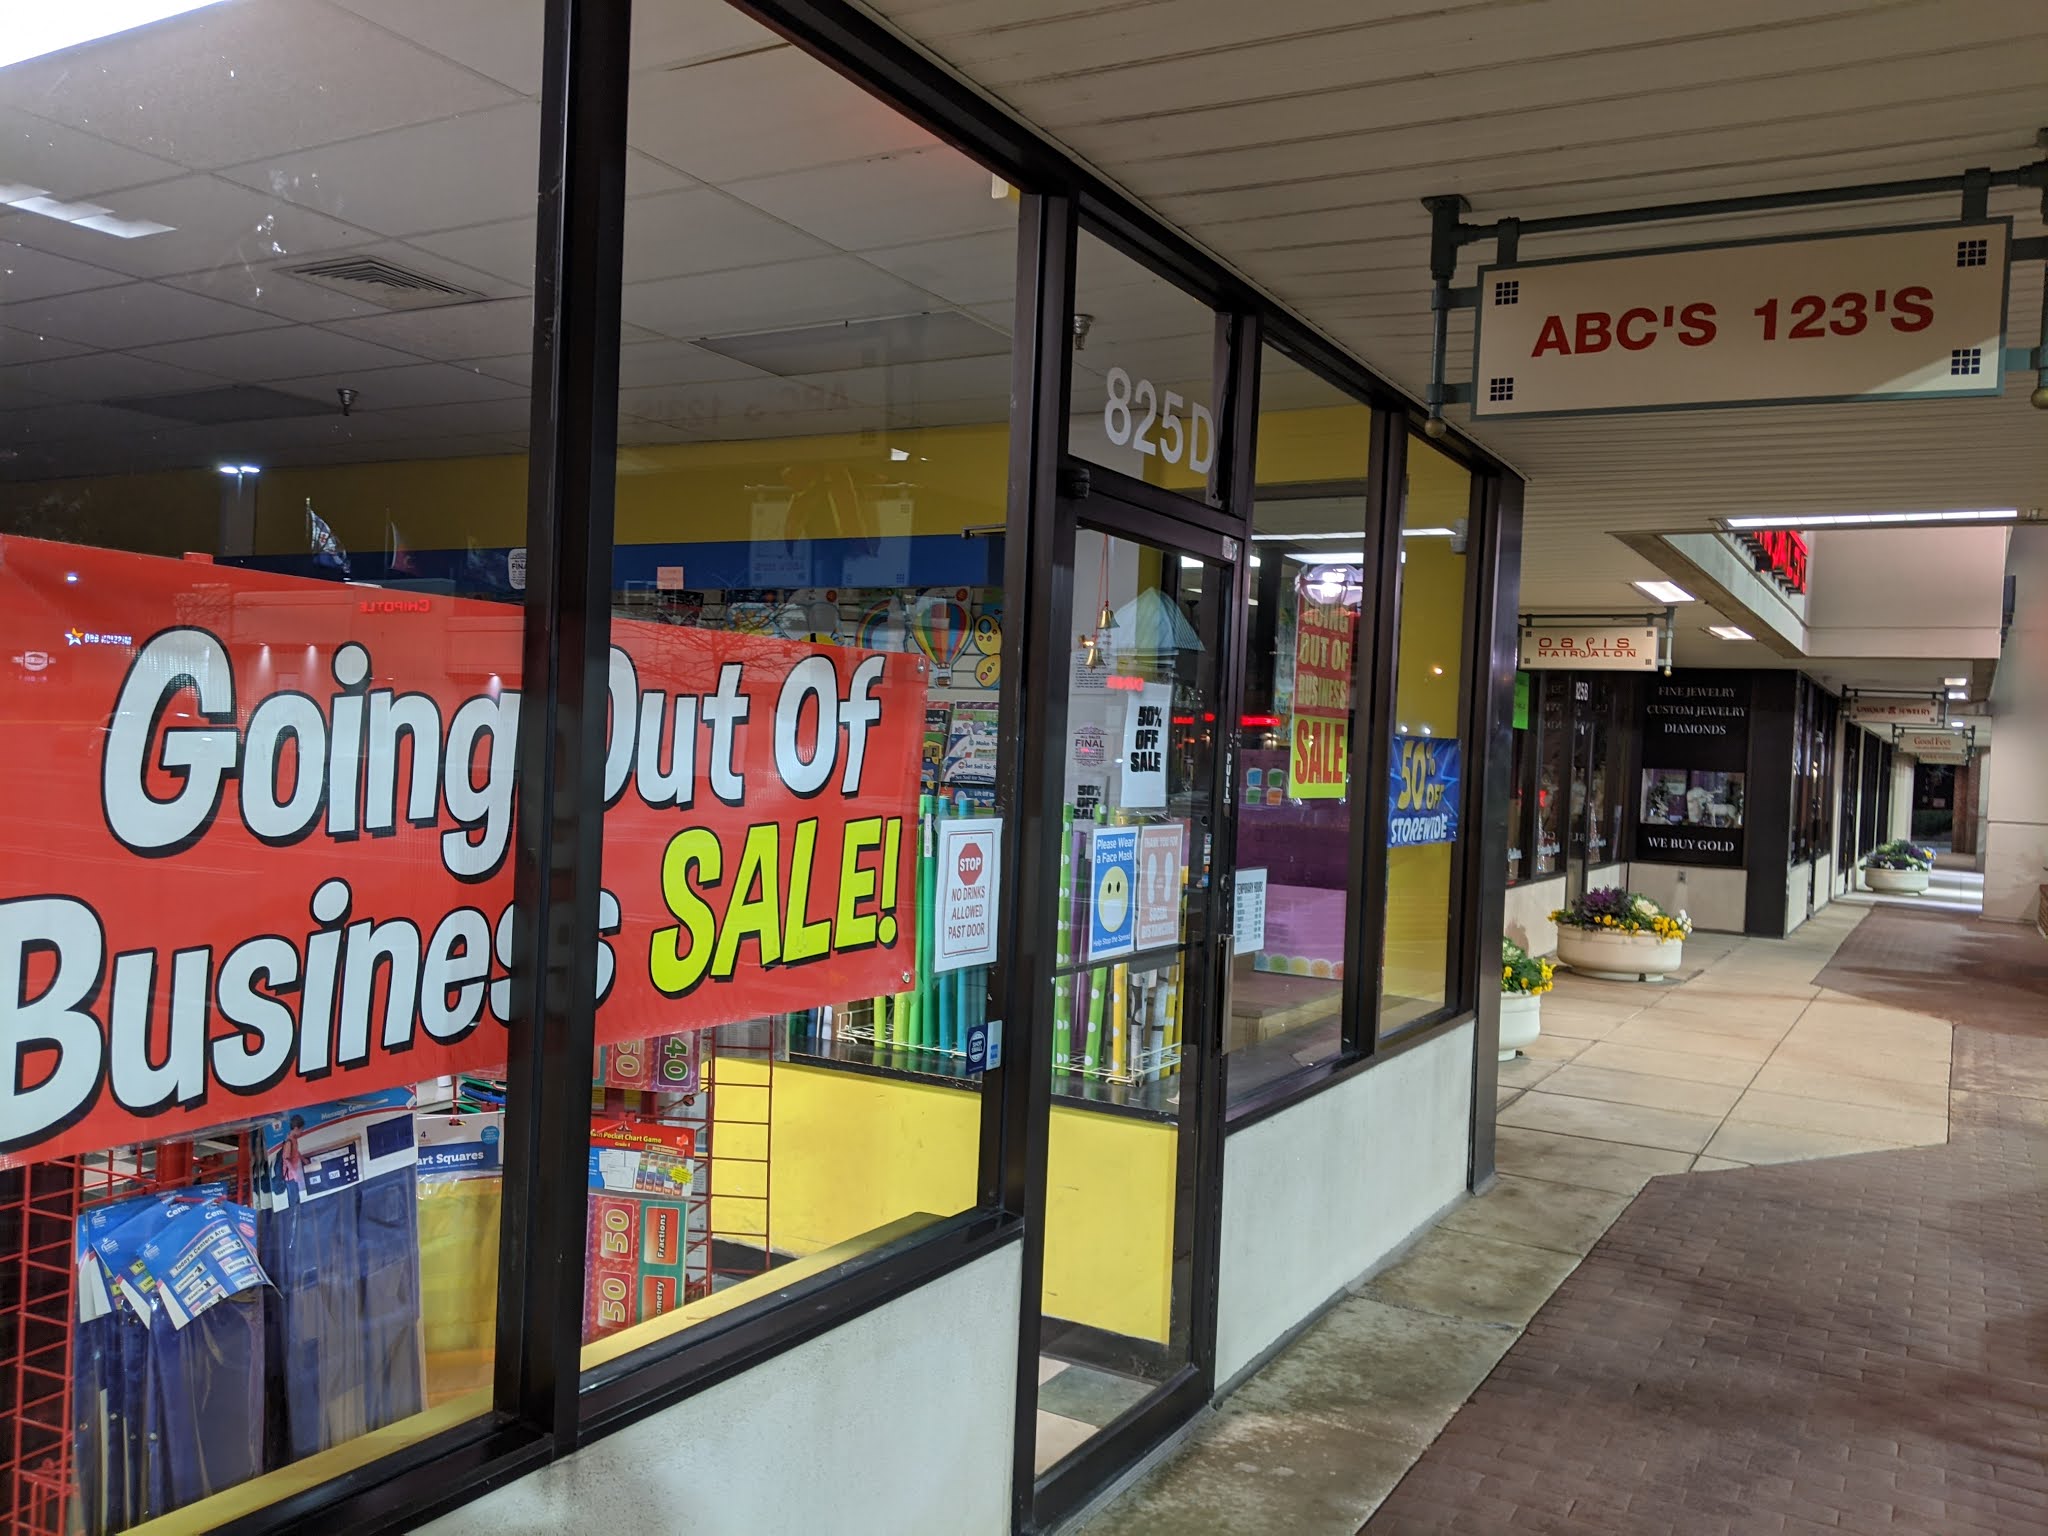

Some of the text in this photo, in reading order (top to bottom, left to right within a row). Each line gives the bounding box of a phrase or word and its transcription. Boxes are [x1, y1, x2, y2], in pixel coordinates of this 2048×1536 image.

[1531, 285, 1935, 358] ABC'S 123'S
[1104, 366, 1215, 474] 825D
[1299, 630, 1350, 672] OUT OF
[1658, 686, 1737, 698] FINE JEWELRY
[1137, 705, 1162, 728] 50%
[1646, 704, 1746, 718] CUSTOM JEWELRY
[1135, 729, 1159, 750] OFF
[1664, 723, 1727, 736] DIAMONDS
[1075, 738, 1104, 748] FINAL
[1294, 718, 1345, 786] SALE
[101, 624, 523, 884] Going
[774, 651, 887, 800] Of
[1130, 751, 1161, 772] SALE
[1396, 740, 1437, 812] 50%
[1077, 785, 1102, 796] 50%
[1425, 782, 1445, 810] OFF
[1076, 797, 1100, 808] OFF
[1074, 808, 1096, 820] SAL
[1390, 813, 1450, 845] STOREWIDE
[1097, 838, 1134, 850] Please Wear
[1648, 836, 1735, 852] WE BUY GOLD
[960, 857, 982, 872] STOP
[1096, 850, 1134, 864] a Face Mask
[952, 885, 985, 902] NO DRINKS
[648, 814, 902, 1001] SALE!
[952, 904, 983, 920] ALLOWED
[948, 922, 985, 940] PAST DOOR
[616, 1039, 640, 1078] 50
[663, 1036, 689, 1081] 40
[603, 1132, 624, 1140] Pocket
[624, 1132, 642, 1142] Chart
[643, 1136, 662, 1144] Game
[436, 1151, 484, 1164] Squares
[604, 1208, 630, 1254] 50
[657, 1214, 666, 1258] Fractions
[175, 1252, 194, 1272] Today's
[194, 1236, 214, 1254] Centers
[602, 1278, 626, 1322] 50
[656, 1281, 665, 1314] ometry
